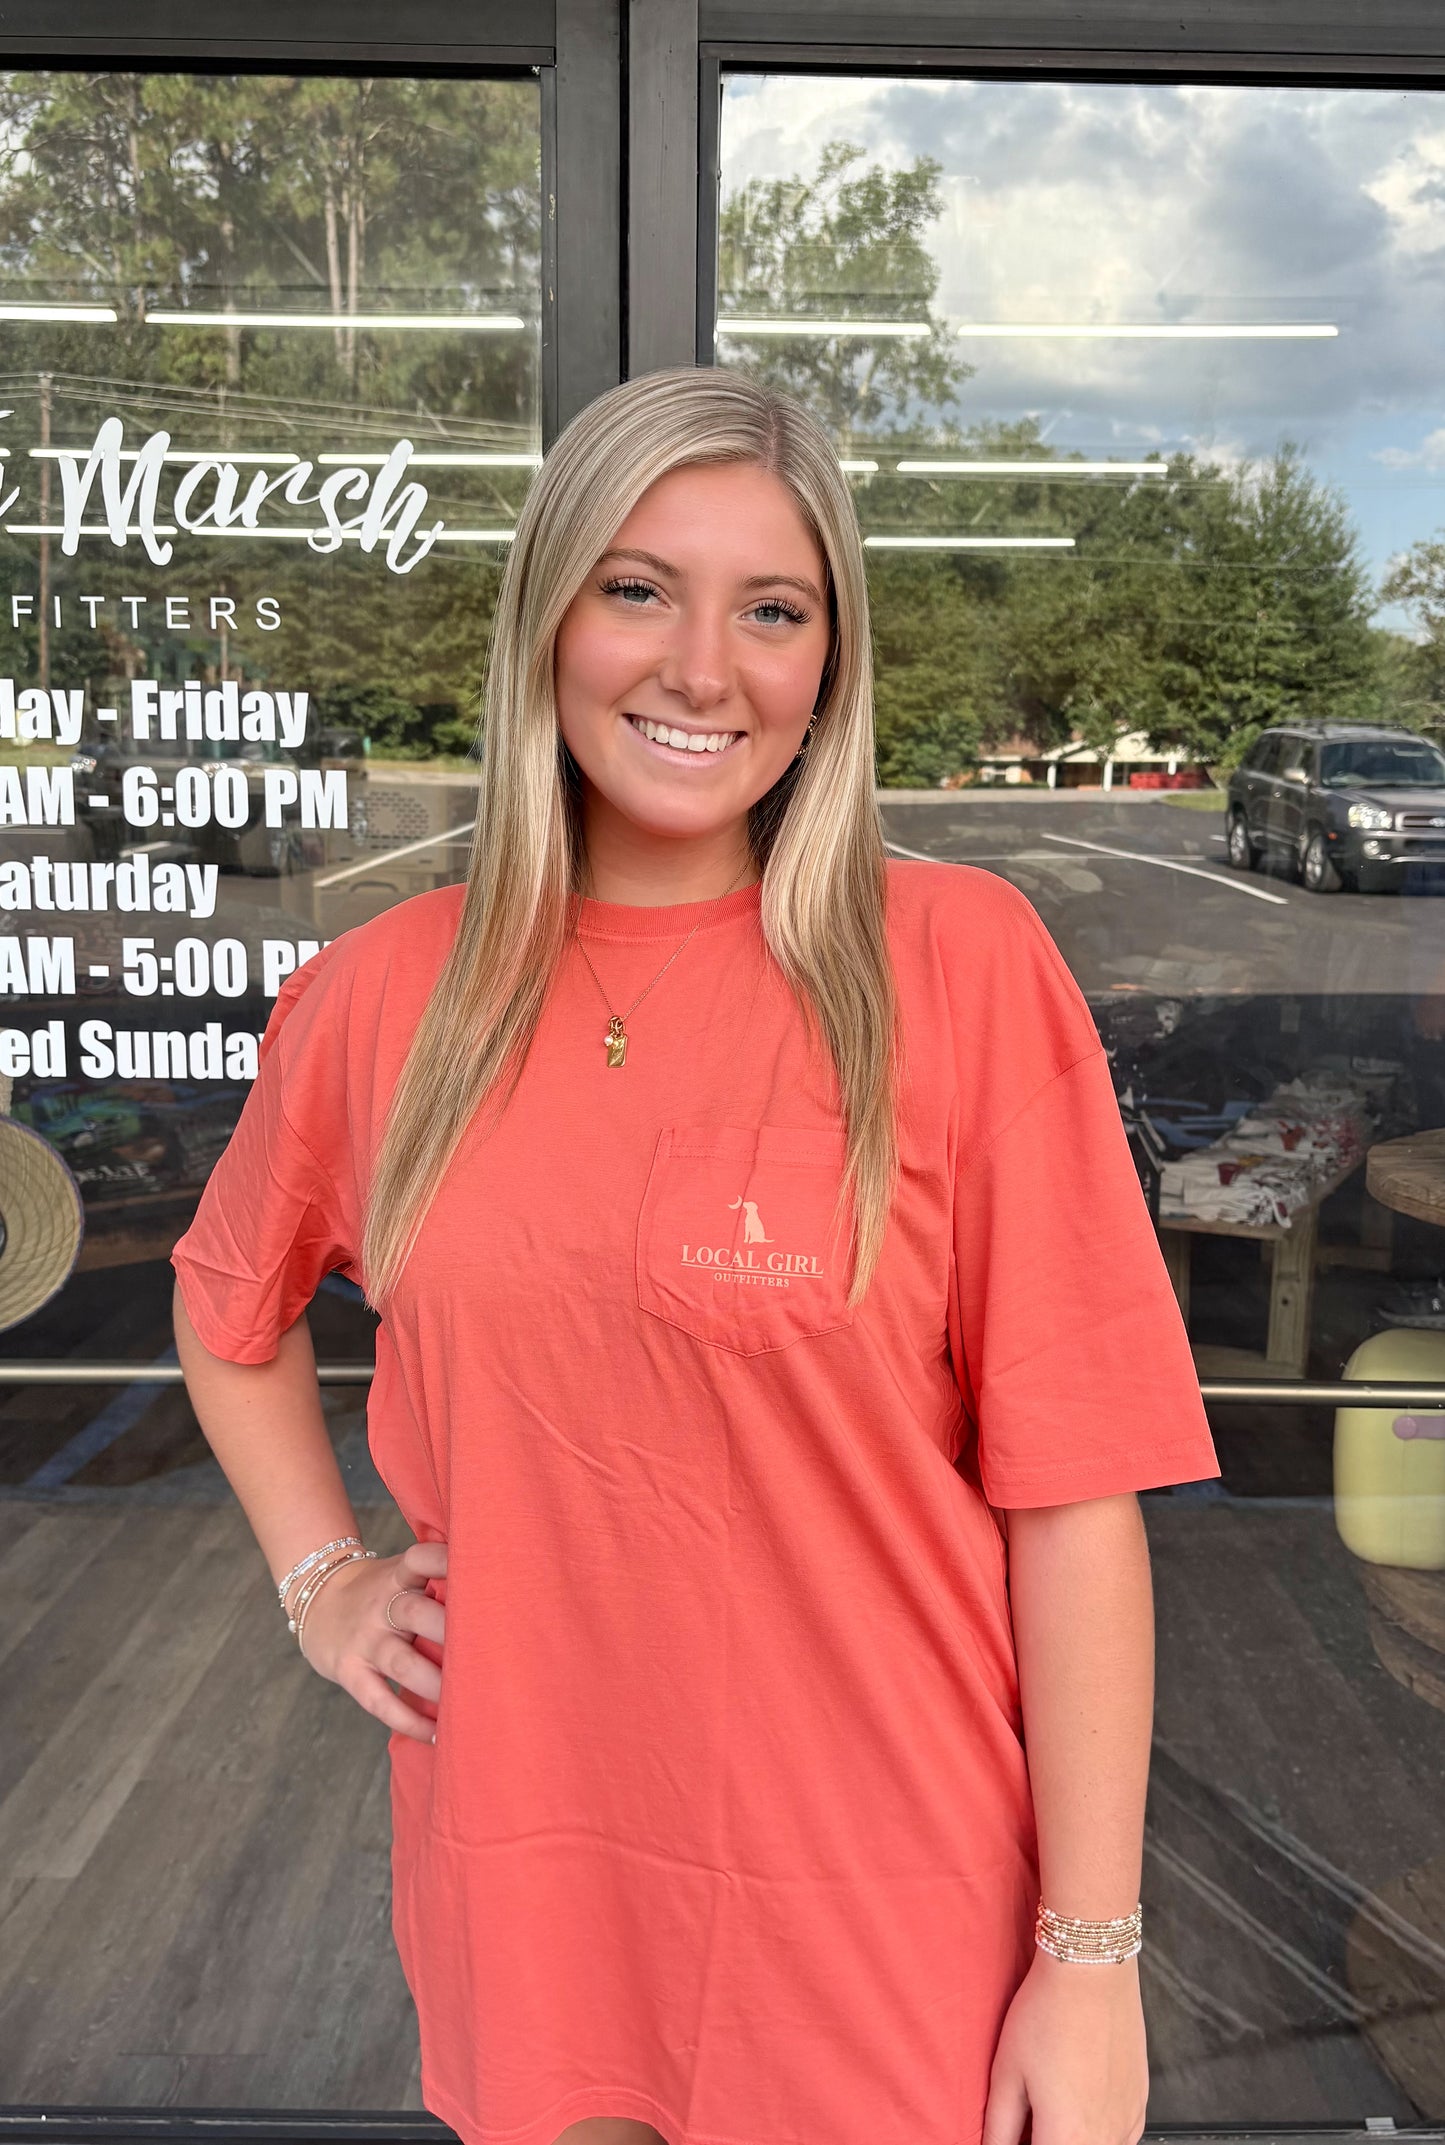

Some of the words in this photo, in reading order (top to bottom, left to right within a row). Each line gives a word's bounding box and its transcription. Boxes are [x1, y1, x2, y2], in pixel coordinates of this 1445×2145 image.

[58, 417, 445, 574] Marsh
[12, 595, 282, 631] FITTERS
[97, 708, 118, 721] -
[130, 679, 309, 748] Friday
[0, 766, 76, 826] AM
[89, 795, 109, 808] -
[122, 766, 249, 829] 6:00
[264, 769, 348, 829] PM
[0, 853, 219, 918] aturday
[0, 936, 76, 995] AM
[89, 965, 109, 977] -
[121, 937, 248, 998] 5:00
[0, 1020, 67, 1078] ed
[79, 1019, 265, 1080] Sunda
[681, 1244, 760, 1269] LOCAL
[767, 1252, 824, 1275] GIRL
[714, 1272, 790, 1288] OUTFITTERS
